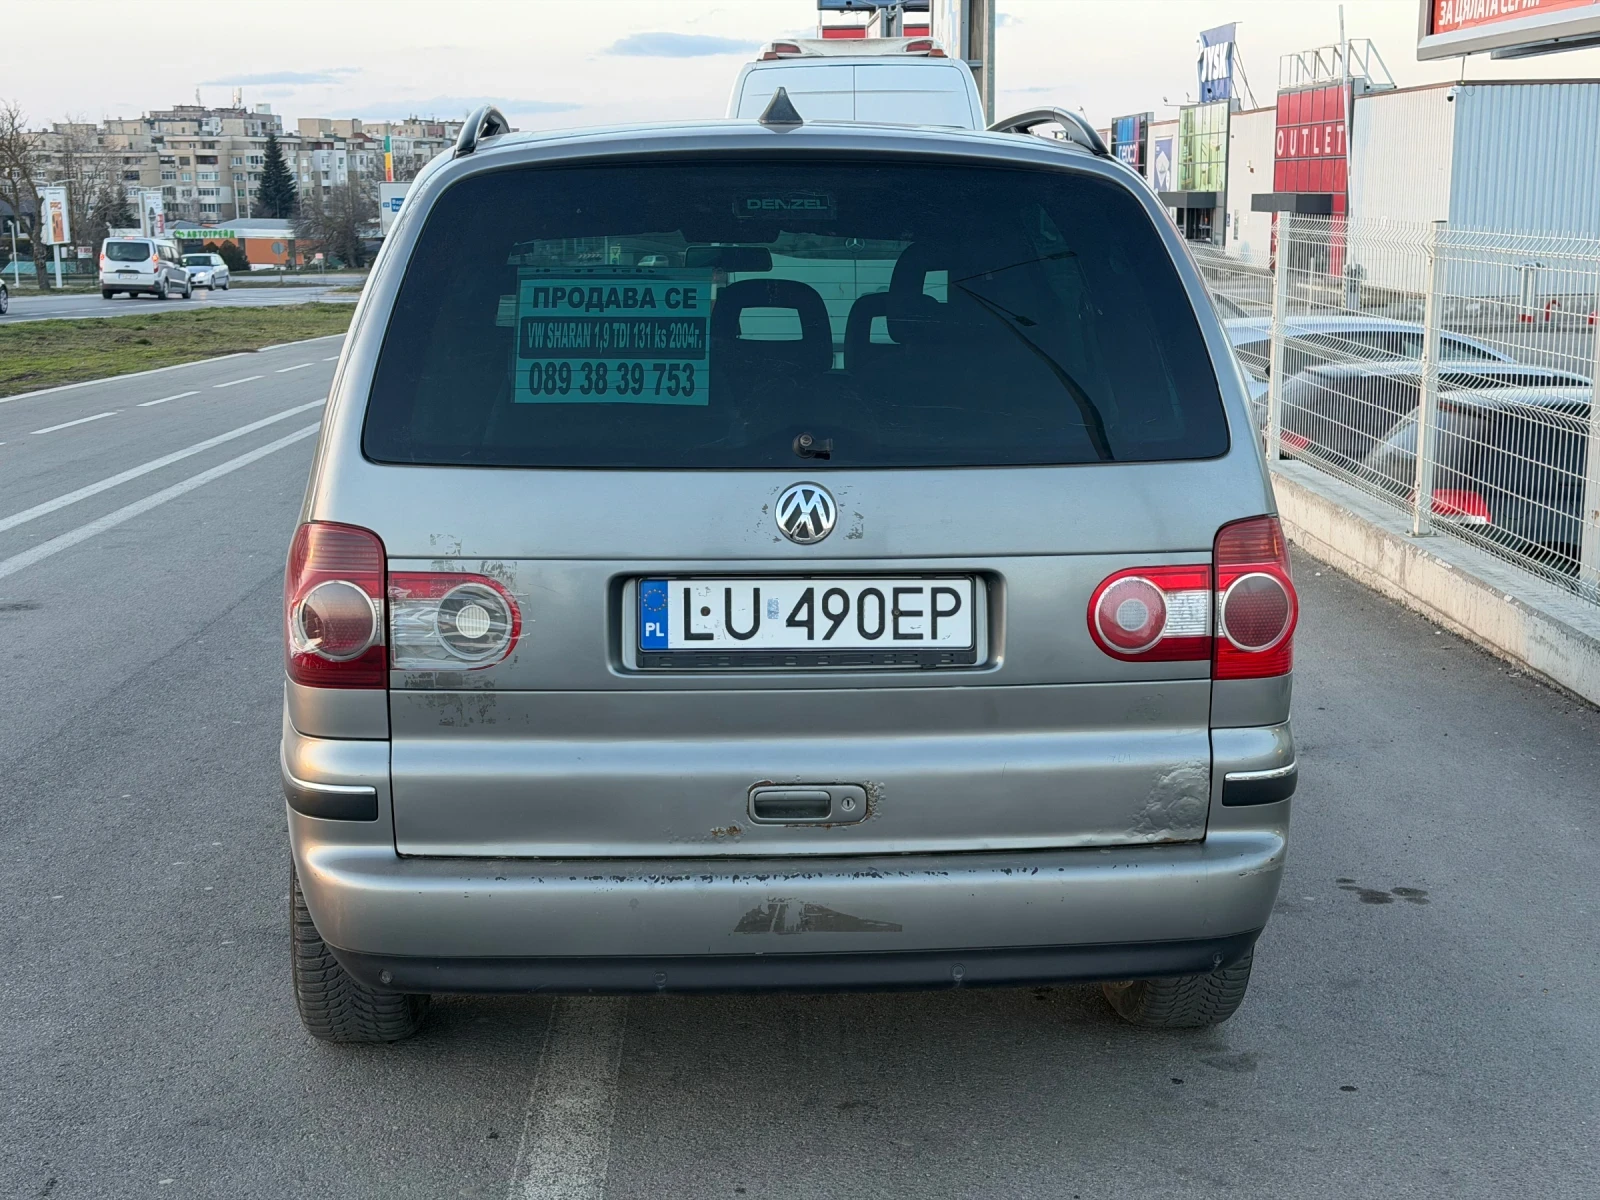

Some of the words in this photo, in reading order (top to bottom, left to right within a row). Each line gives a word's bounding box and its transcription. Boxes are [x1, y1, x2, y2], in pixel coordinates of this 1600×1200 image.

[1438, 1, 1453, 26] ЗА
[1201, 41, 1229, 83] JYSK
[1277, 125, 1345, 156] OUTLET
[746, 198, 828, 210] DENZEL
[187, 229, 235, 239] АВТОТРЕЙД
[532, 287, 657, 313] ПРОДАВА
[664, 287, 698, 309] СЕ
[528, 322, 545, 348] VW
[547, 322, 591, 348] SHARAN
[594, 322, 610, 353] 1,9
[612, 322, 630, 348] TDI
[633, 322, 651, 348] 131
[654, 323, 667, 348] ks
[529, 361, 572, 396] 089
[579, 361, 608, 396] 38
[615, 361, 644, 396] 39
[652, 362, 695, 397] 753
[683, 587, 761, 641] LU
[785, 587, 962, 641] 490EP
[645, 622, 665, 637] PL
